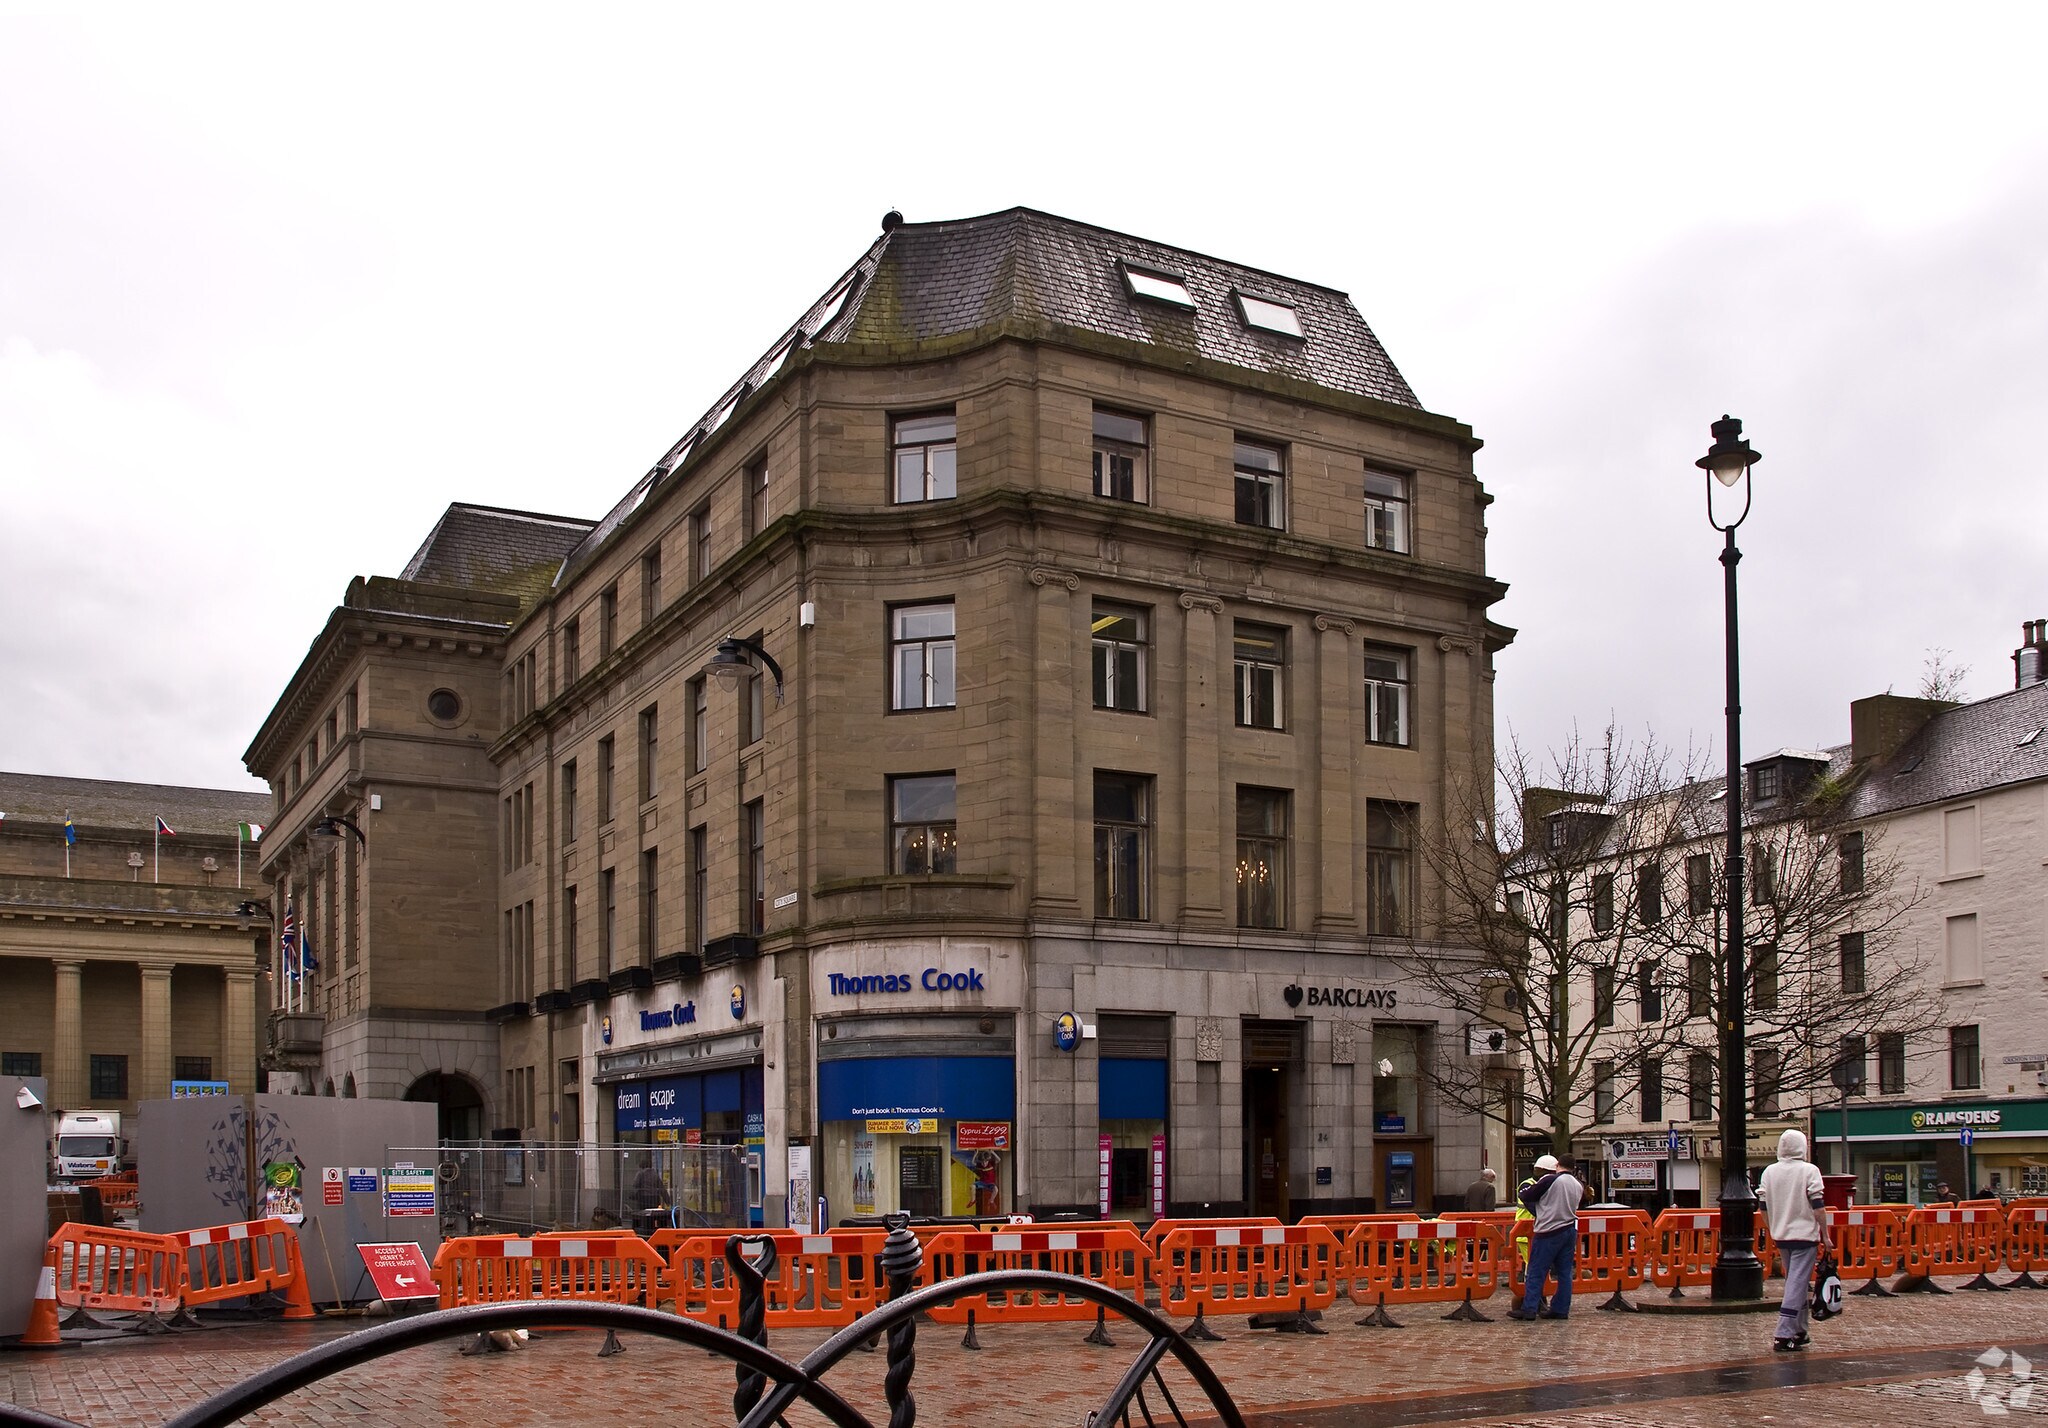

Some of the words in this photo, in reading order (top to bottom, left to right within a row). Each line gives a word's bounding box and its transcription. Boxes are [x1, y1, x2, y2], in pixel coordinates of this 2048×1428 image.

[828, 973, 911, 996] Thomas
[922, 968, 984, 991] Cook
[1308, 987, 1397, 1008] BARCLAYS
[639, 1010, 673, 1032] Thomas
[673, 1001, 696, 1025] Cook
[1061, 1031, 1074, 1040] Cook
[618, 1089, 641, 1110] dream
[650, 1089, 675, 1110] escape
[865, 1107, 875, 1115] just
[876, 1106, 890, 1114] book
[1926, 1110, 2001, 1125] RAMSDENS
[960, 1127, 981, 1135] Cyprus
[982, 1125, 1007, 1135] £299
[1884, 1173, 1904, 1181] Gold
[397, 1259, 416, 1267] HOUSE
[1828, 1284, 1841, 1304] JD
